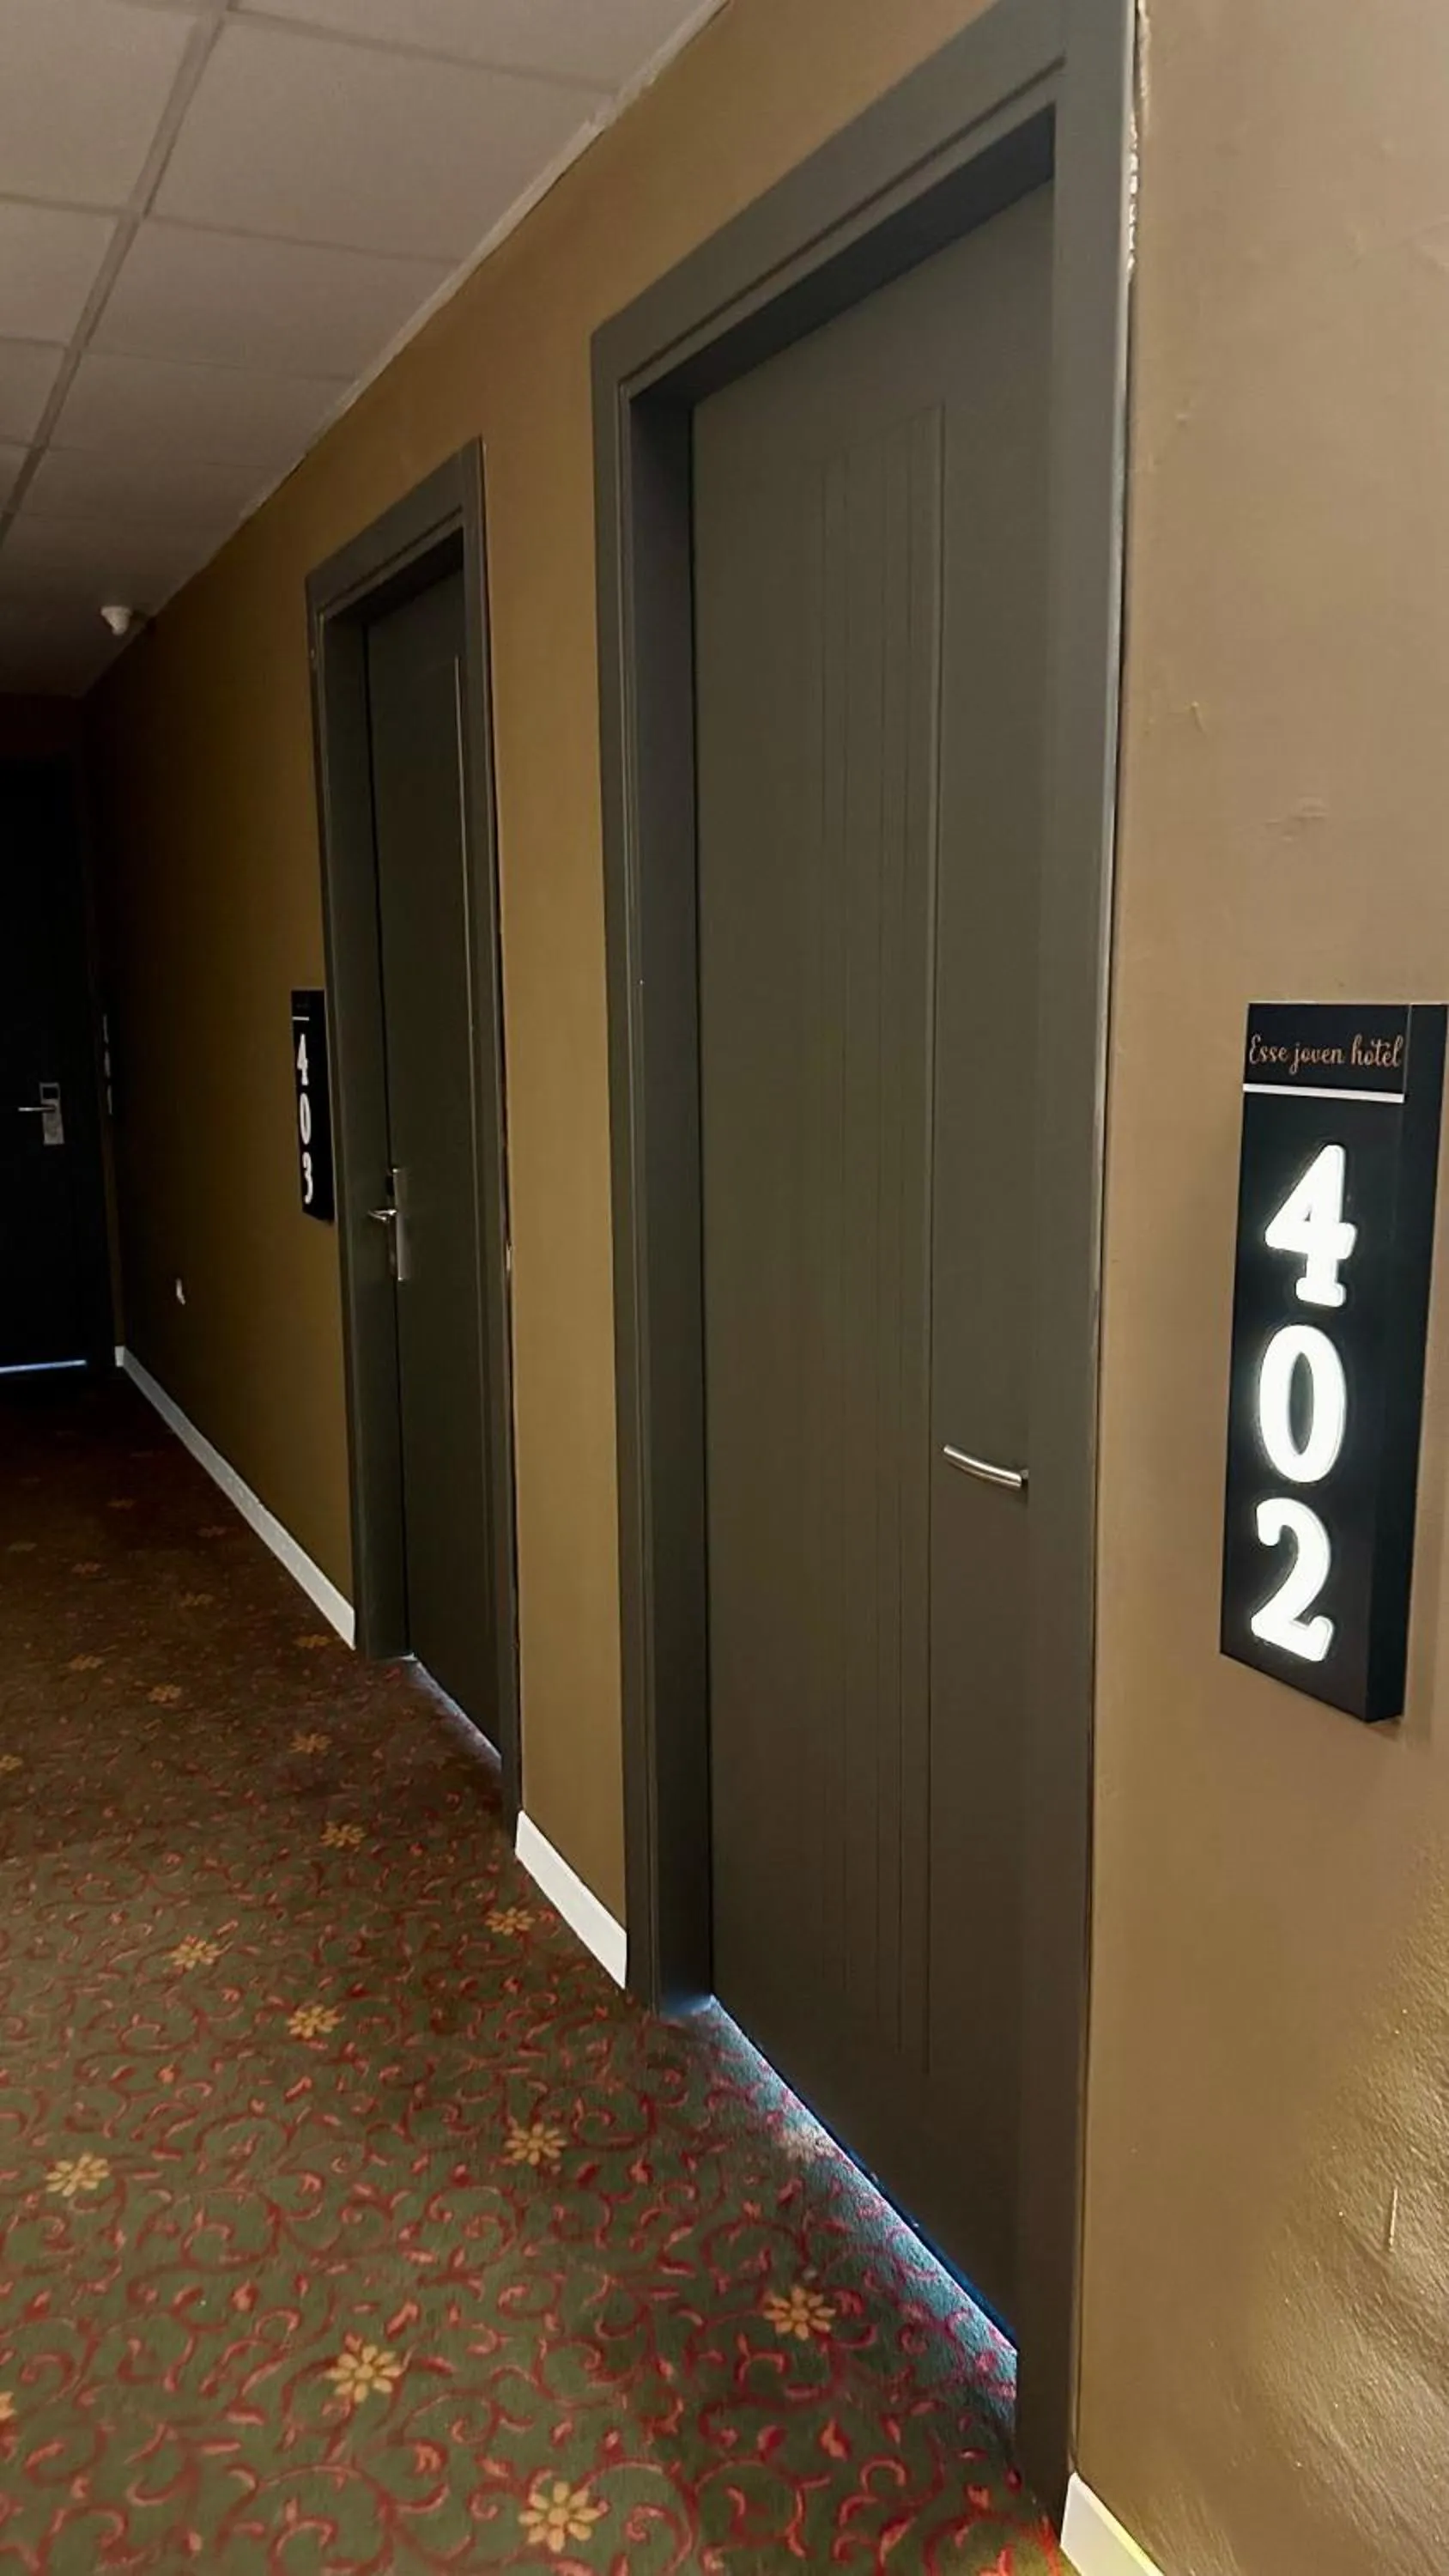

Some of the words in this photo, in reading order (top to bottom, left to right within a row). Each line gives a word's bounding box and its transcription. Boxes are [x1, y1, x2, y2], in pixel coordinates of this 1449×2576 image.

[296, 1033, 313, 1205] 403
[1248, 1033, 1288, 1065] Esse
[1288, 1042, 1345, 1075] joven
[1350, 1033, 1404, 1068] hotel
[1250, 1144, 1357, 1662] 402
